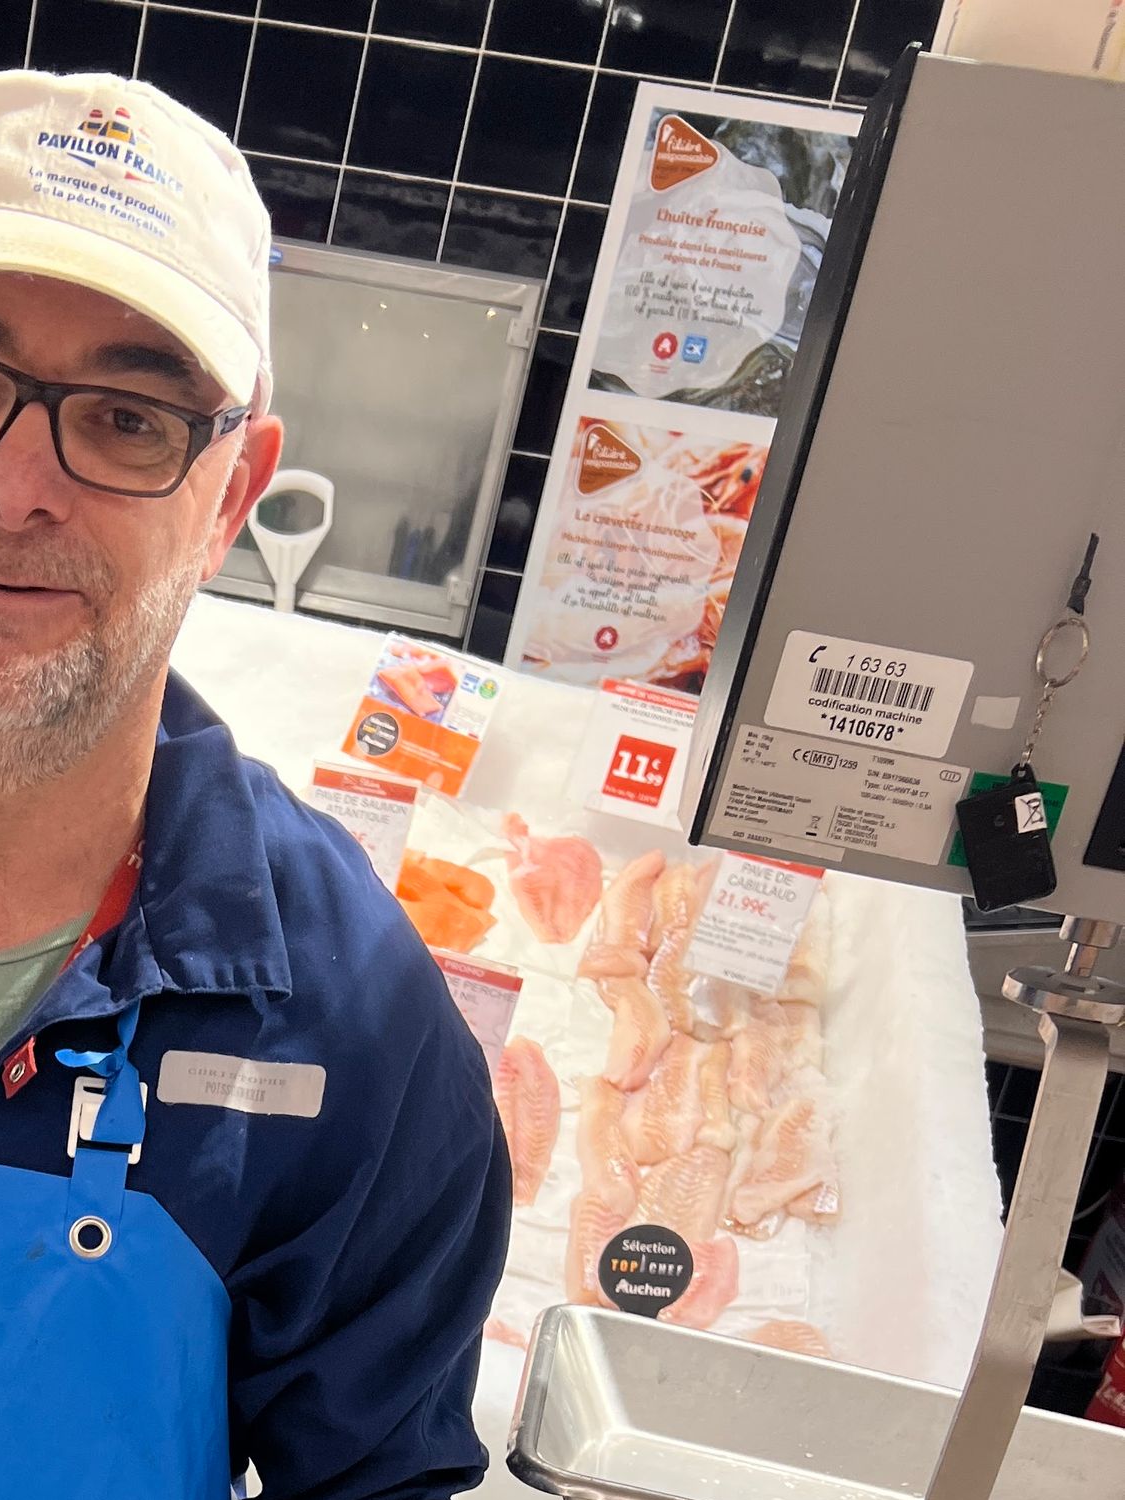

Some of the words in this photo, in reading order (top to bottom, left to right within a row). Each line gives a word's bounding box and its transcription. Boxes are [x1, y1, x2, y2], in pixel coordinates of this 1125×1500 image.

[38, 132, 120, 160] PAVILLON
[124, 150, 184, 191] FRANCE
[47, 172, 97, 191] marque
[100, 184, 123, 201] des
[52, 186, 64, 198] la
[67, 191, 107, 211] pêche
[109, 204, 166, 239] française
[847, 654, 856, 668] 1
[860, 656, 882, 673] 63
[885, 661, 907, 678] 63
[808, 697, 873, 716] codification
[875, 709, 923, 725] machine
[612, 750, 650, 784] 11
[813, 753, 834, 766] M19
[838, 758, 858, 770] 1259
[741, 862, 774, 880] PAVE
[775, 872, 795, 886] DE
[727, 874, 797, 903] CABILLAUD
[622, 1239, 676, 1255] Sélection
[611, 1258, 638, 1273] TOP
[649, 1261, 684, 1277] CHEF
[615, 1278, 671, 1298] Auchan
